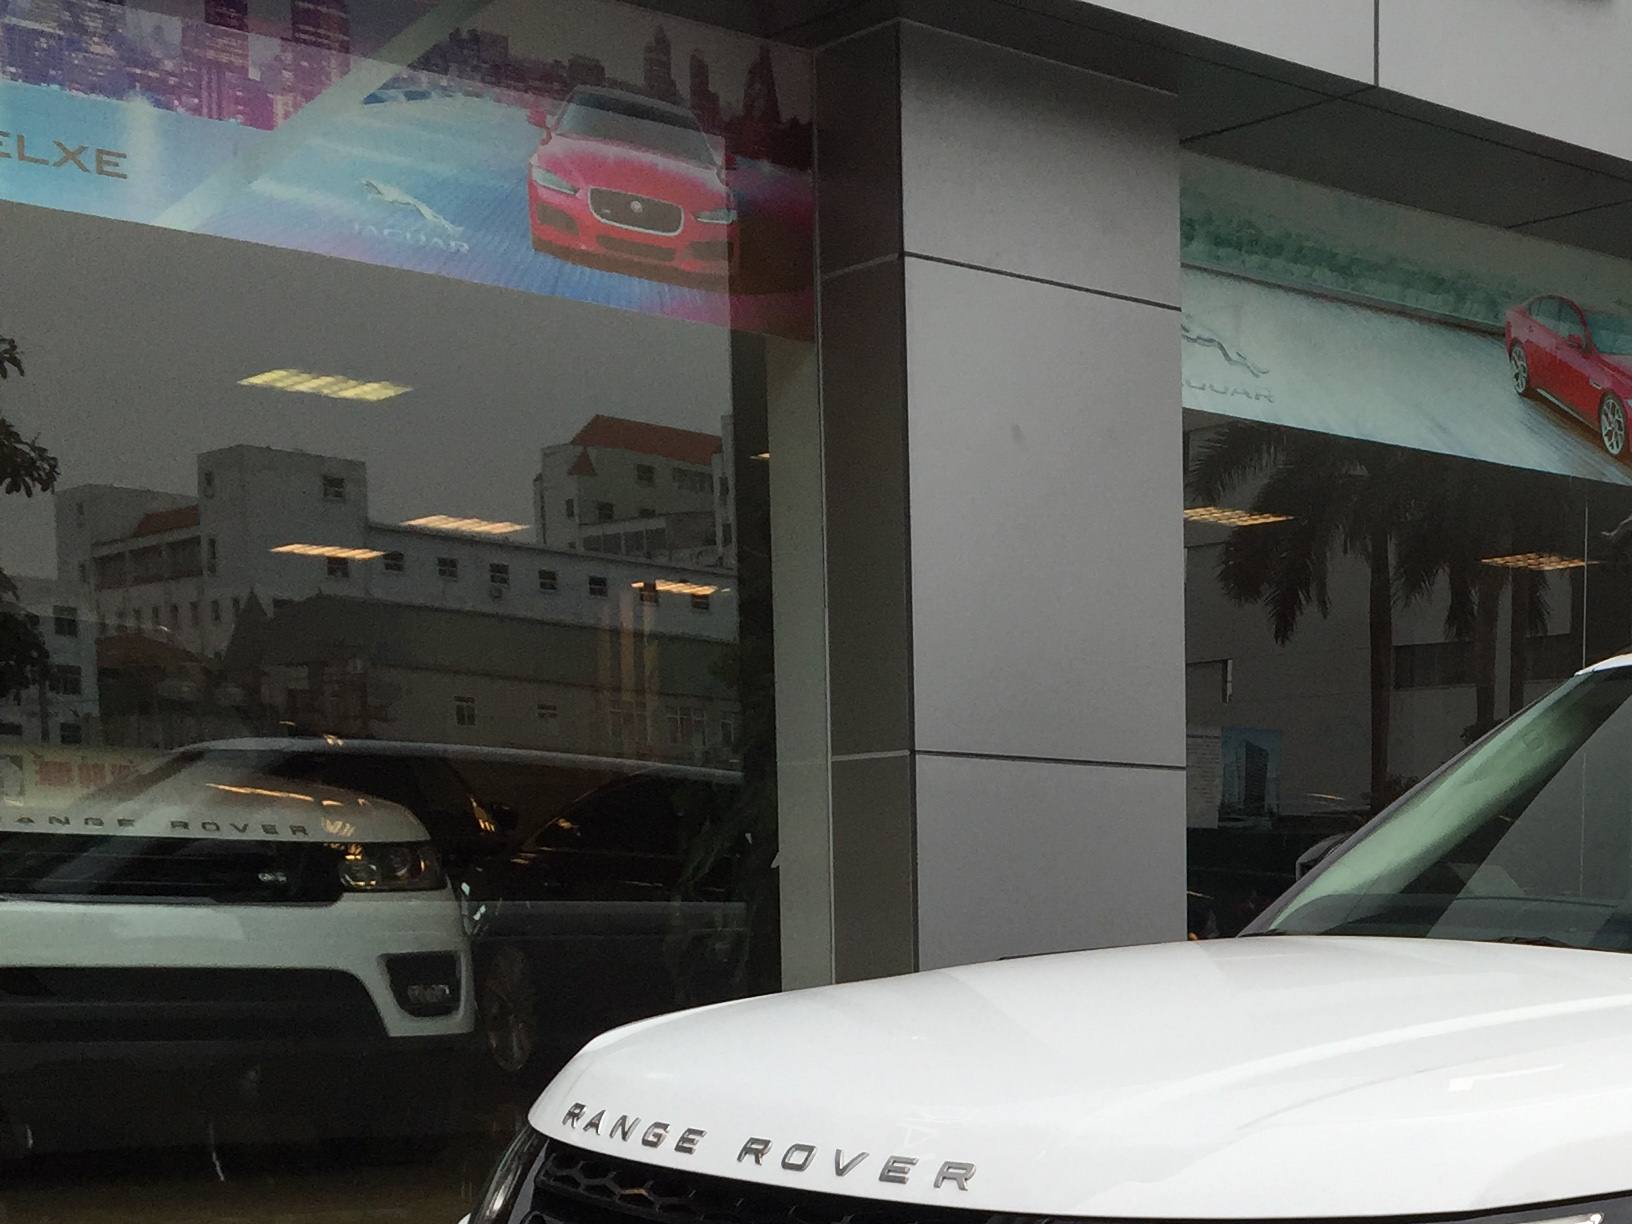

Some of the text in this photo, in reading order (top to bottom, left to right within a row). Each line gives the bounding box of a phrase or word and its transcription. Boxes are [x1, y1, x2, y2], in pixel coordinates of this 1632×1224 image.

[169, 819, 311, 836] ROVER
[561, 1101, 978, 1192] RANGE ROVER
